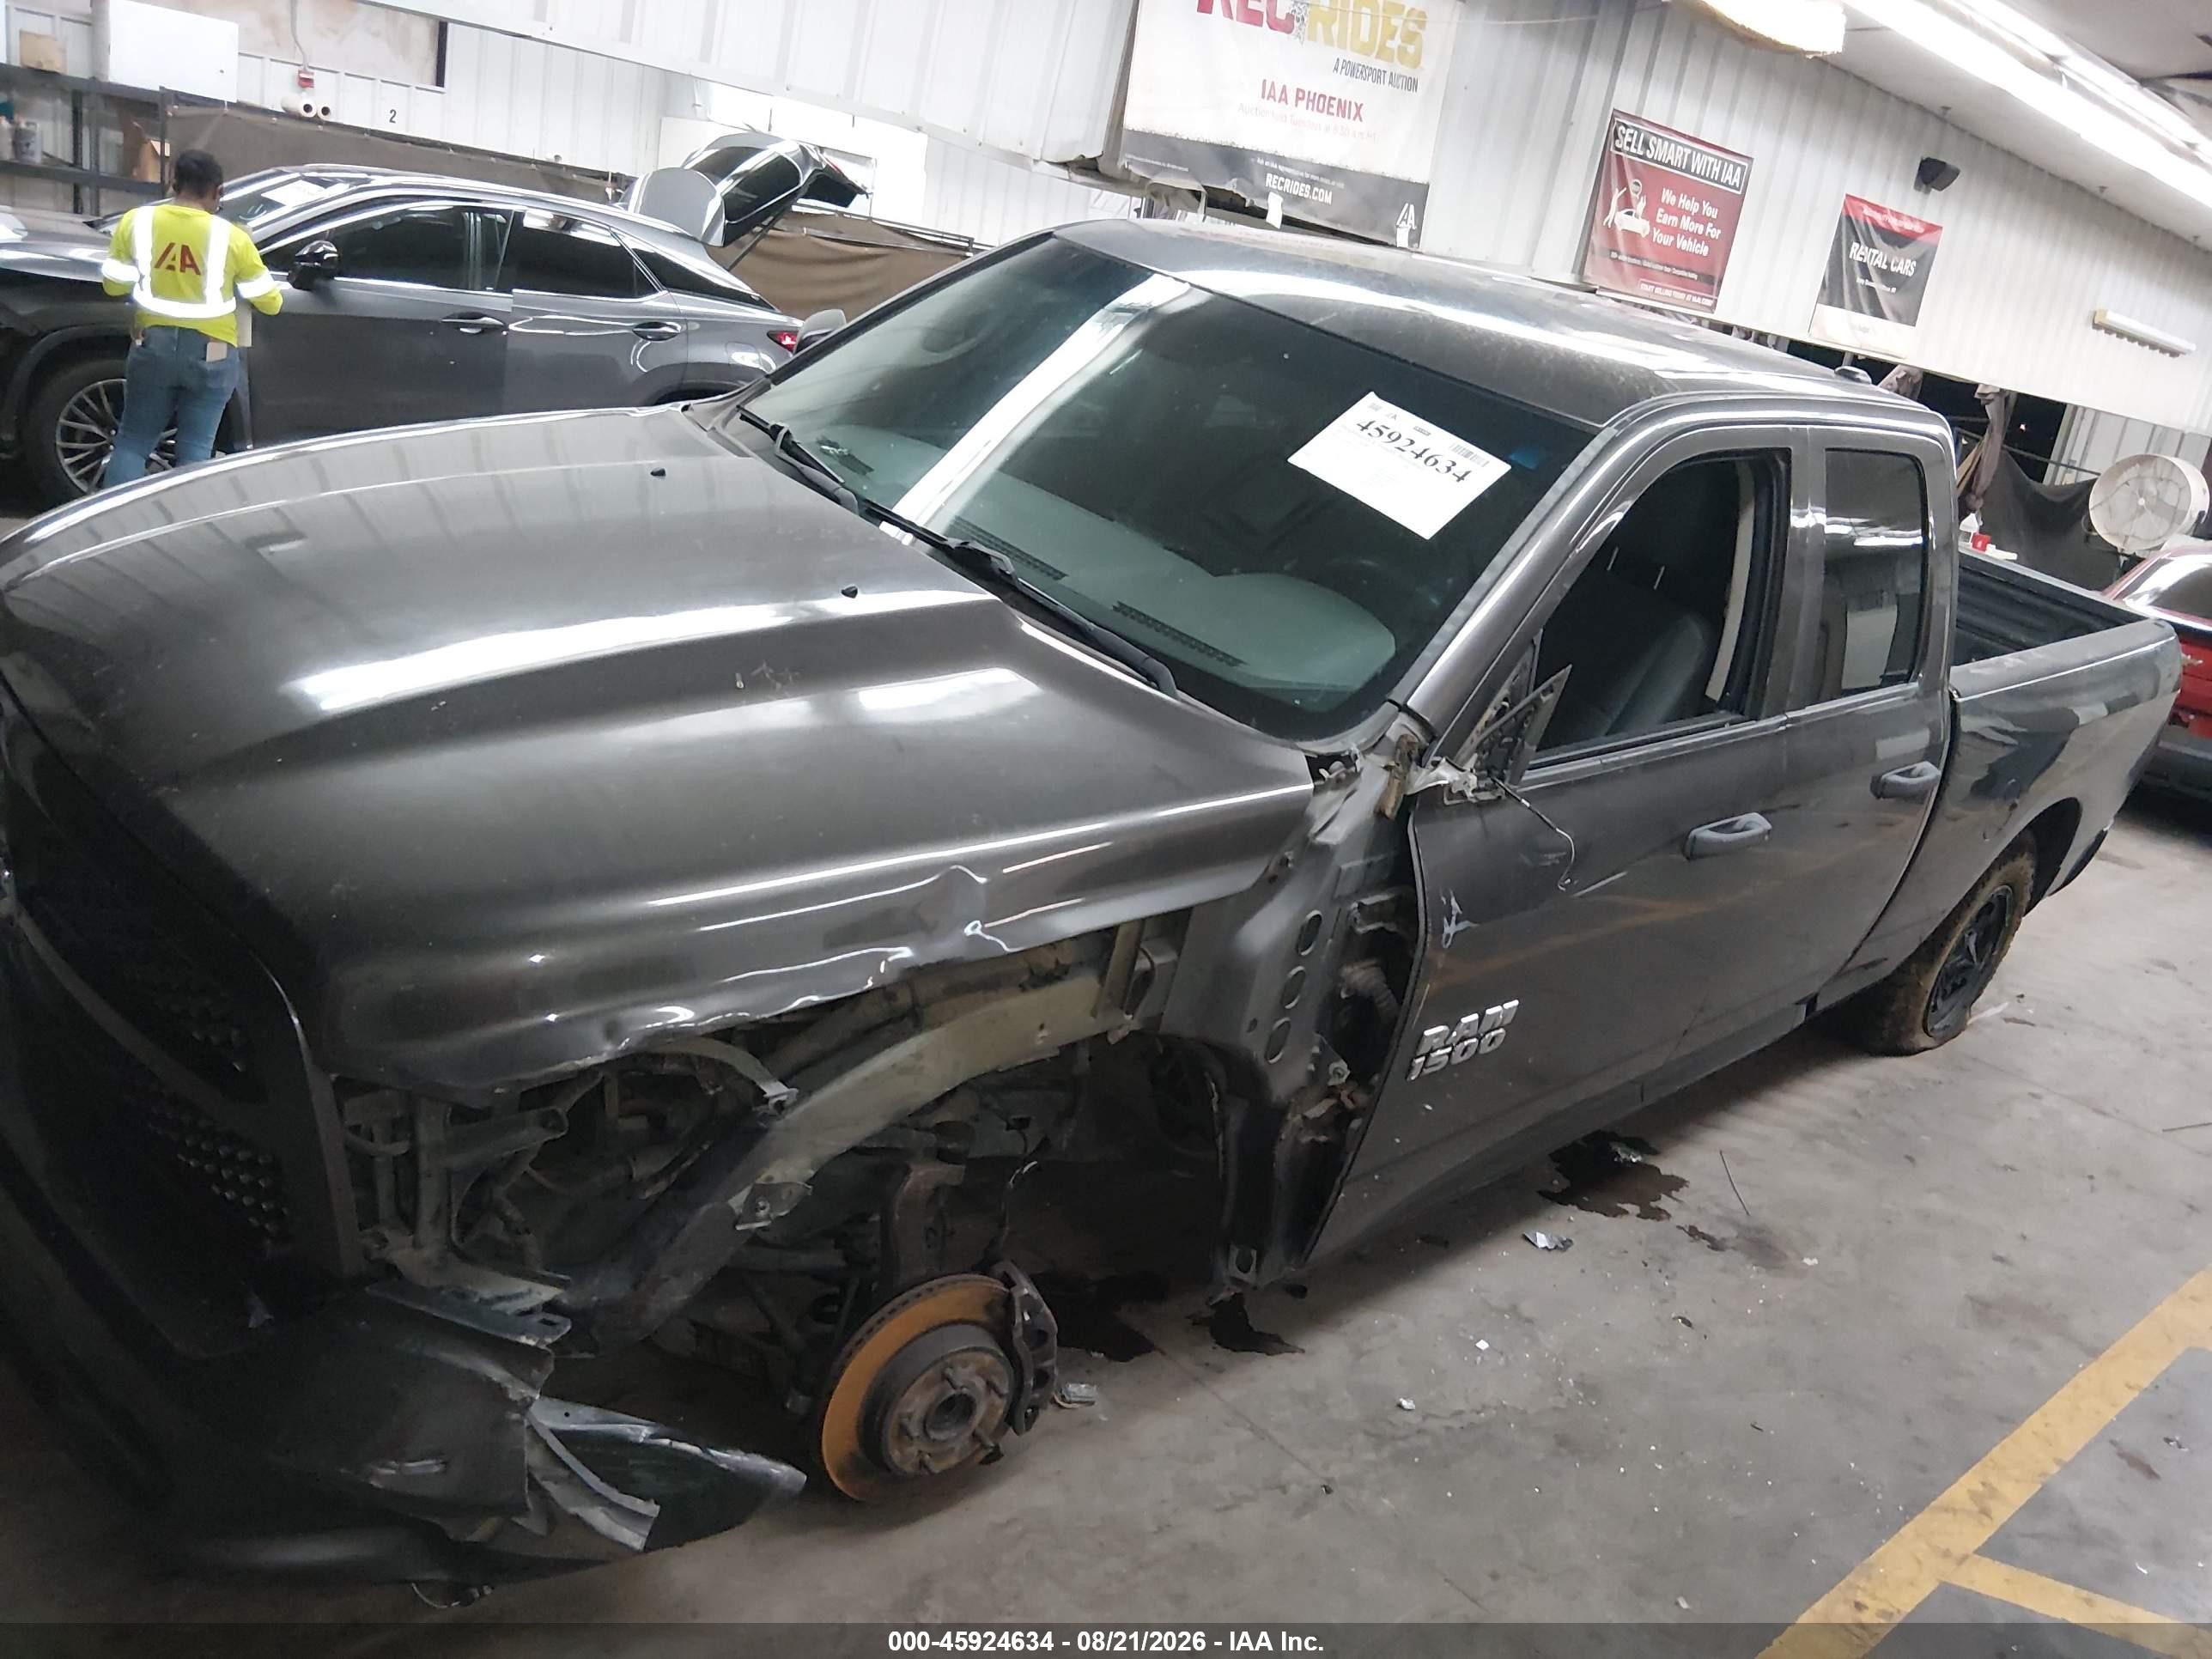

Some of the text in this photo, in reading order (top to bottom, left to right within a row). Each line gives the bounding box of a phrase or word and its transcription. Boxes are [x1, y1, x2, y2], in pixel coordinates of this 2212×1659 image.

[1306, 0, 1427, 70] RIDES
[1333, 58, 1419, 93] A POWERSPORT AUCTION
[389, 109, 397, 124] 2
[1261, 79, 1364, 122] IAA PHOENIX
[1615, 125, 1741, 188] SELL SMART WITH IAA
[1266, 173, 1333, 205] RECRIDES.COM
[1661, 188, 1718, 219] We Help You
[1656, 208, 1722, 240] Earn More For
[1652, 228, 1710, 257] Your Vehicle
[1850, 241, 1917, 276] RENTAL CARS
[1356, 420, 1473, 483] 45924634
[1417, 999, 1519, 1056] RAM
[1407, 1027, 1506, 1082] 1500
